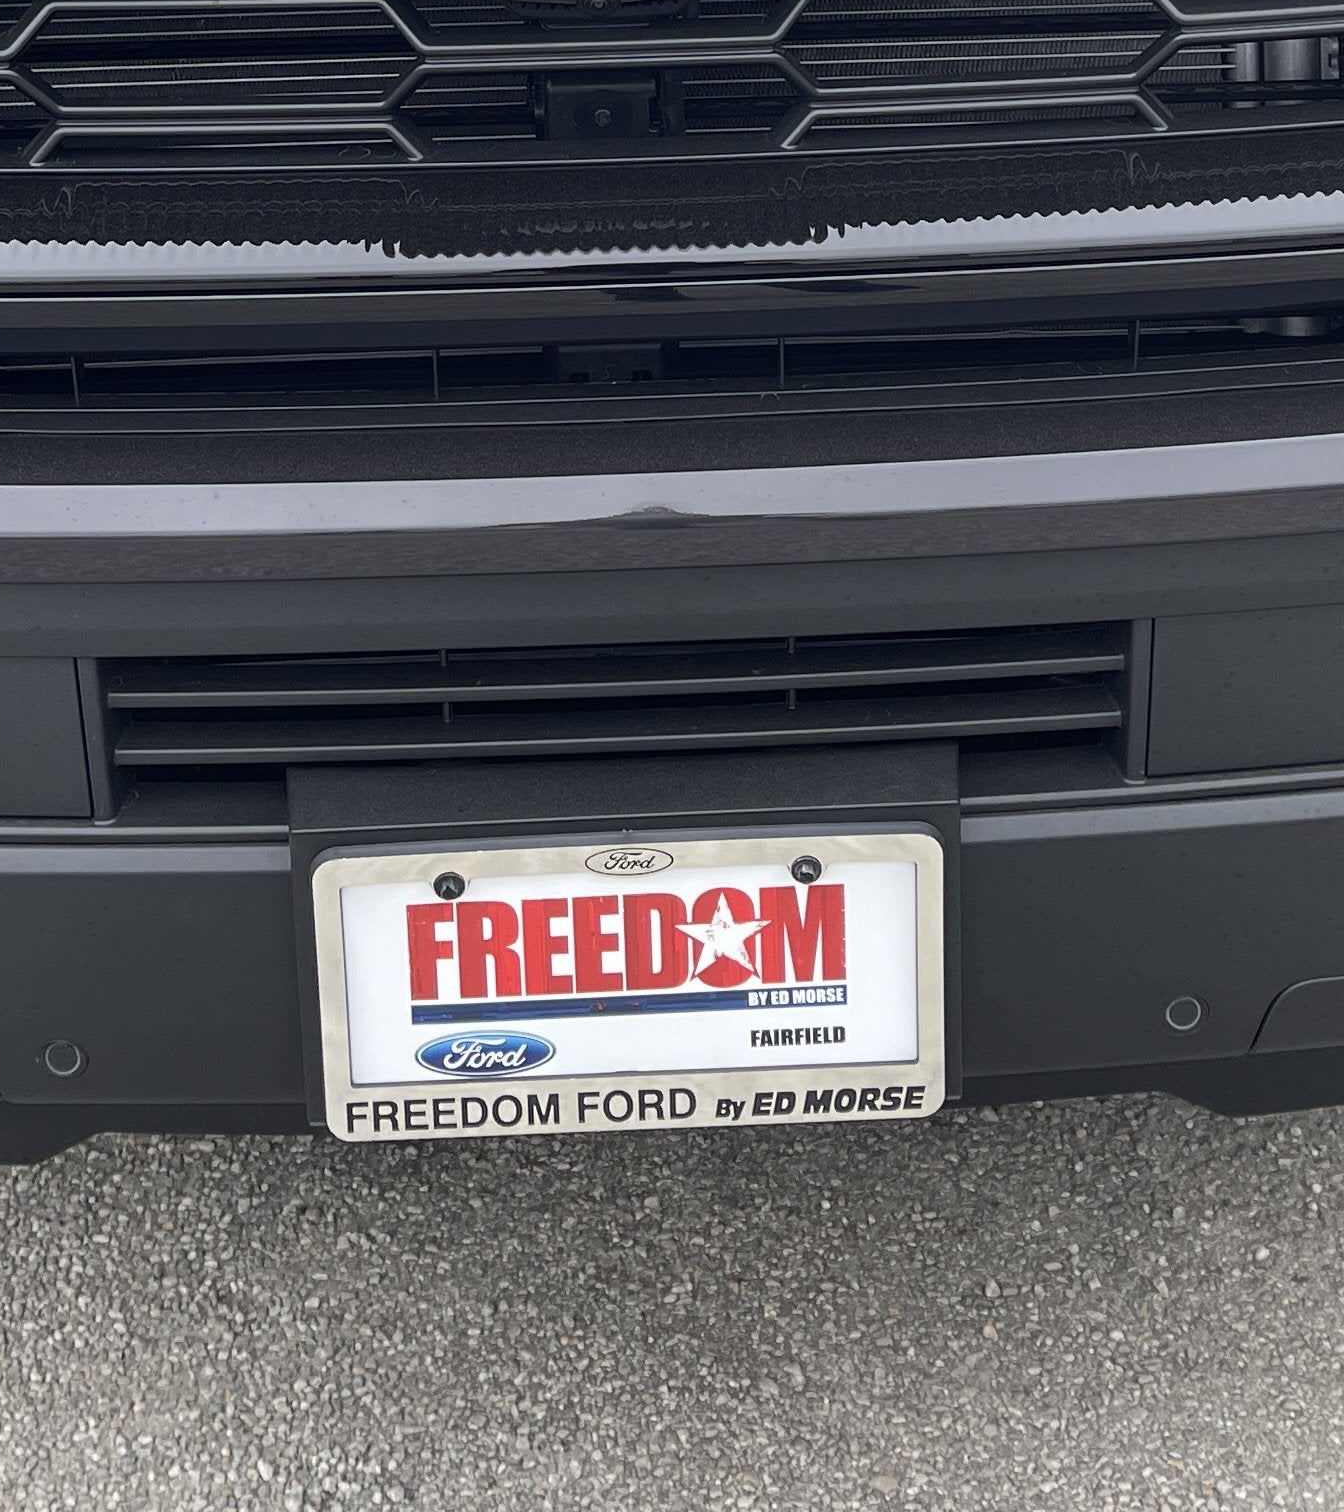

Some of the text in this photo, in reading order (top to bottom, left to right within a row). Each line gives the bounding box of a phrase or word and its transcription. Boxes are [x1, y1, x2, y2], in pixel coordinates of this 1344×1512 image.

[604, 851, 656, 870] Ford
[406, 883, 847, 1000] FREEDOM
[748, 987, 845, 1007] BY ED MORSE
[750, 1026, 847, 1048] FAIRFIELD
[443, 1038, 527, 1070] Ford
[346, 1085, 926, 1133] FREEDOM FORD By ED MORSE
